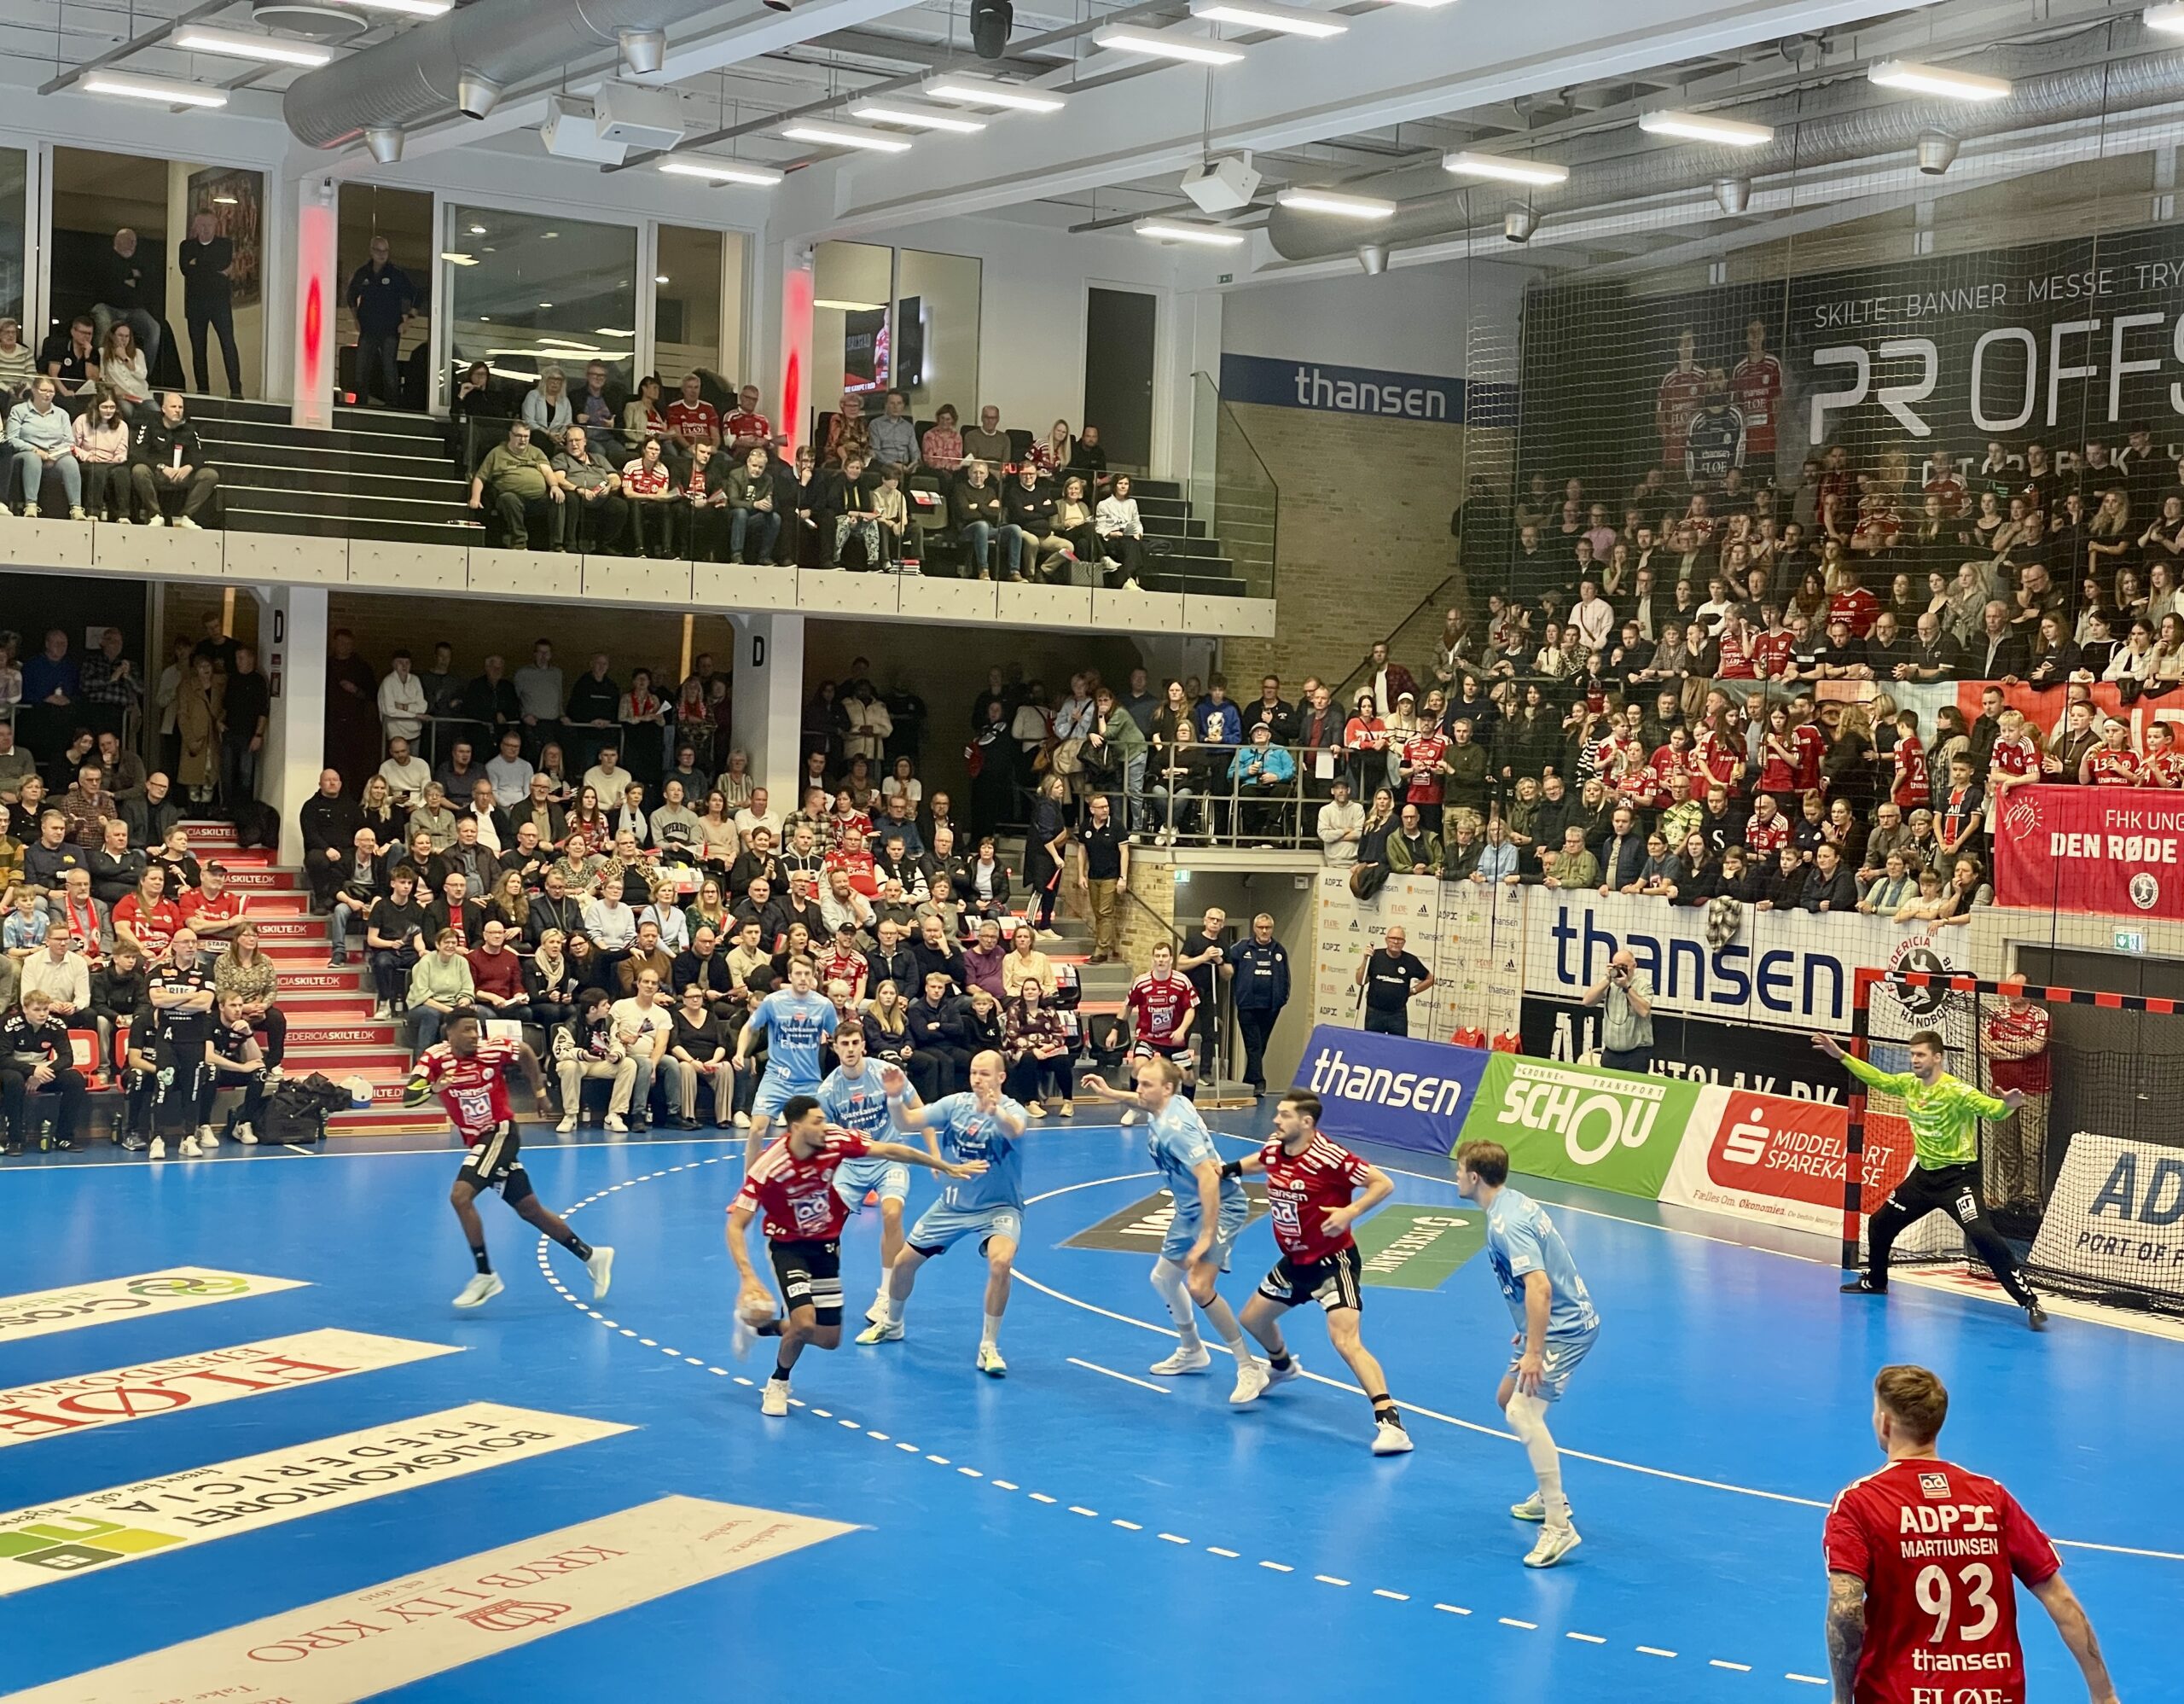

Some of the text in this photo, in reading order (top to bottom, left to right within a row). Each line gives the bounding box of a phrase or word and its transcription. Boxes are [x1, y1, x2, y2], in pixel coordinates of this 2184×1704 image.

[1815, 298, 1888, 329] SKILTE
[1907, 283, 2007, 317] BANNER
[2028, 269, 2114, 303] MESSE
[1970, 309, 2184, 432] OFF
[1294, 366, 1446, 418] thansen
[274, 609, 283, 643] D
[753, 636, 764, 667] D
[2093, 758, 2108, 772] 13
[2098, 776, 2128, 785] thansen
[2106, 809, 2184, 831] FHK UNG
[2050, 832, 2178, 864] DEN RØDE
[1552, 906, 1844, 1019] thansen
[1887, 936, 1931, 992] FEDERICIA
[1489, 984, 1515, 996] thansen
[777, 1067, 792, 1079] 19
[1310, 1048, 1461, 1116] thansen
[1592, 1079, 1664, 1097] TRANSPORT
[1497, 1079, 1661, 1166] SCHOU
[1772, 1129, 1894, 1166] MIDDELRT
[1764, 1149, 1885, 1188] SPAREKASE
[945, 1185, 959, 1205] 11
[1693, 1189, 1720, 1204] Fælles
[1363, 1225, 1446, 1275] JYSKE BANK
[2076, 1231, 2132, 1258] PORT
[2138, 1242, 2168, 1263] OF
[107, 1422, 497, 1514] FREDERICIA
[175, 1430, 556, 1527] BOLIGKONTORET
[1900, 1537, 1999, 1559] MARTIUNSEN
[246, 1544, 630, 1663] KRYB I LY KRO
[1914, 1562, 2000, 1643] 93
[1911, 1649, 2012, 1672] thansen
